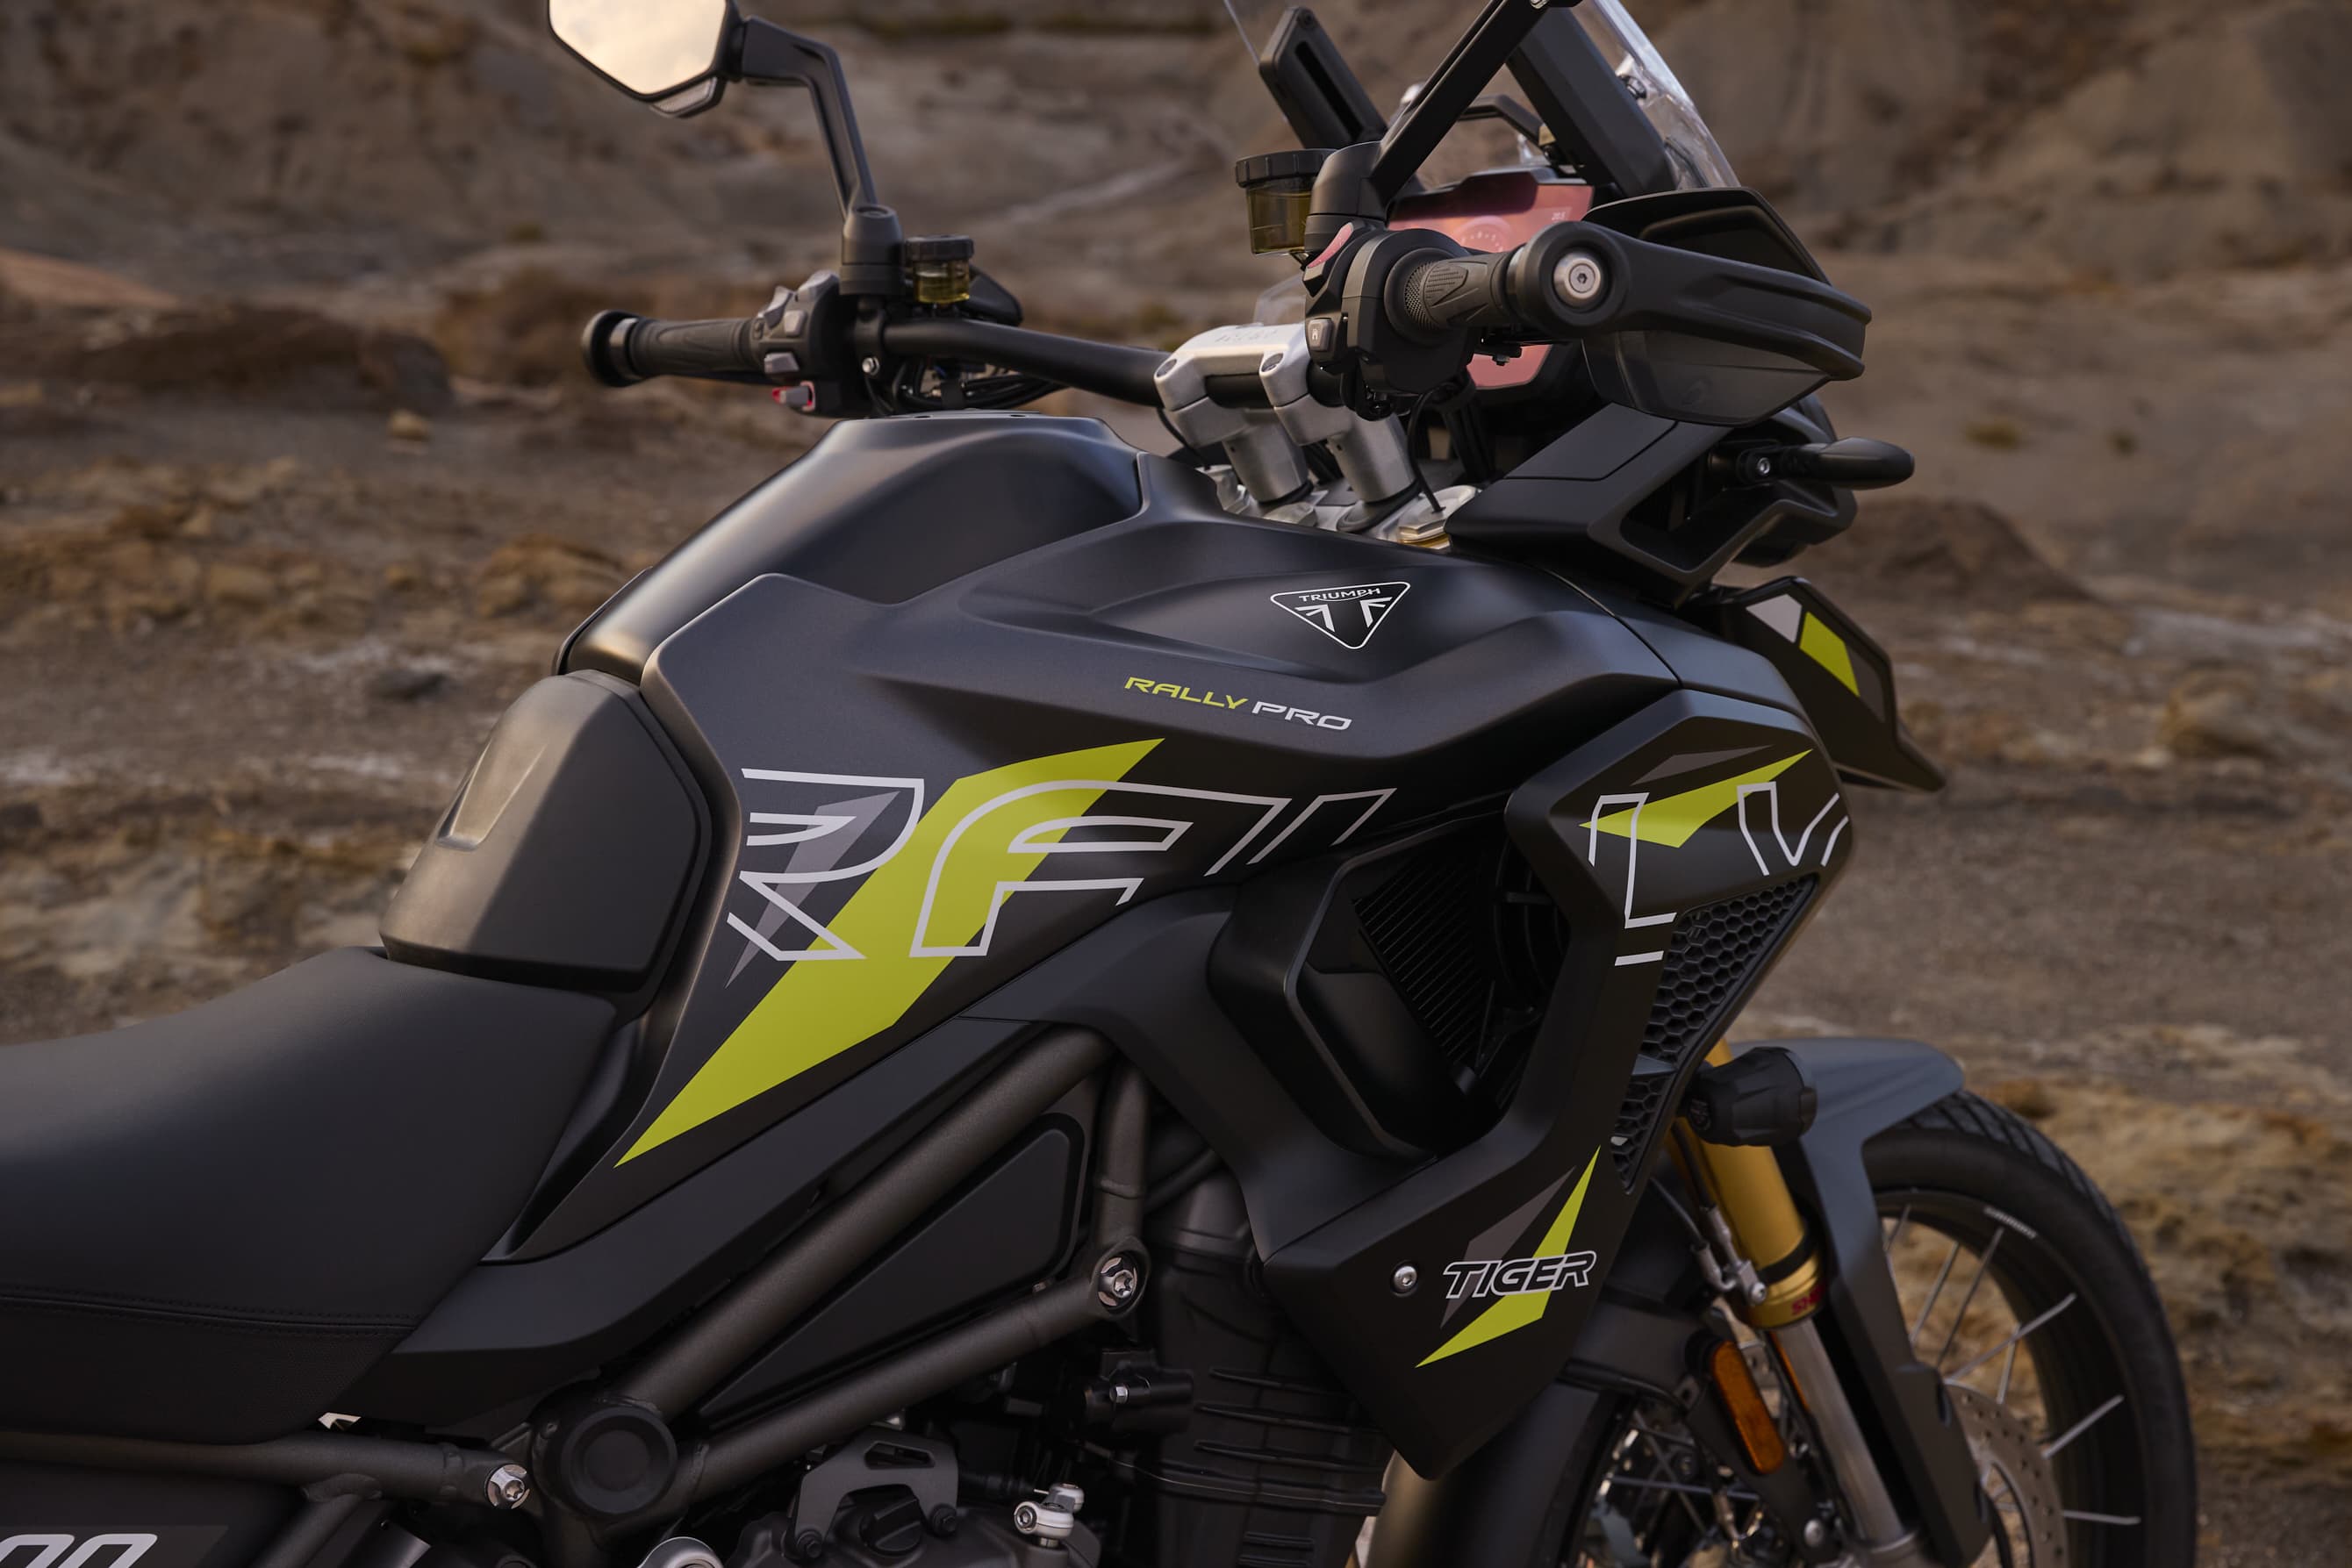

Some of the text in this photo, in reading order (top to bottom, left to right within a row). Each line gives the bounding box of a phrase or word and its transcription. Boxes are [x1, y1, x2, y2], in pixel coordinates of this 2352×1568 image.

[1299, 587, 1381, 602] TRIUMPH
[1124, 677, 1352, 730] RALLY PRO
[1443, 1250, 1597, 1299] TIGER
